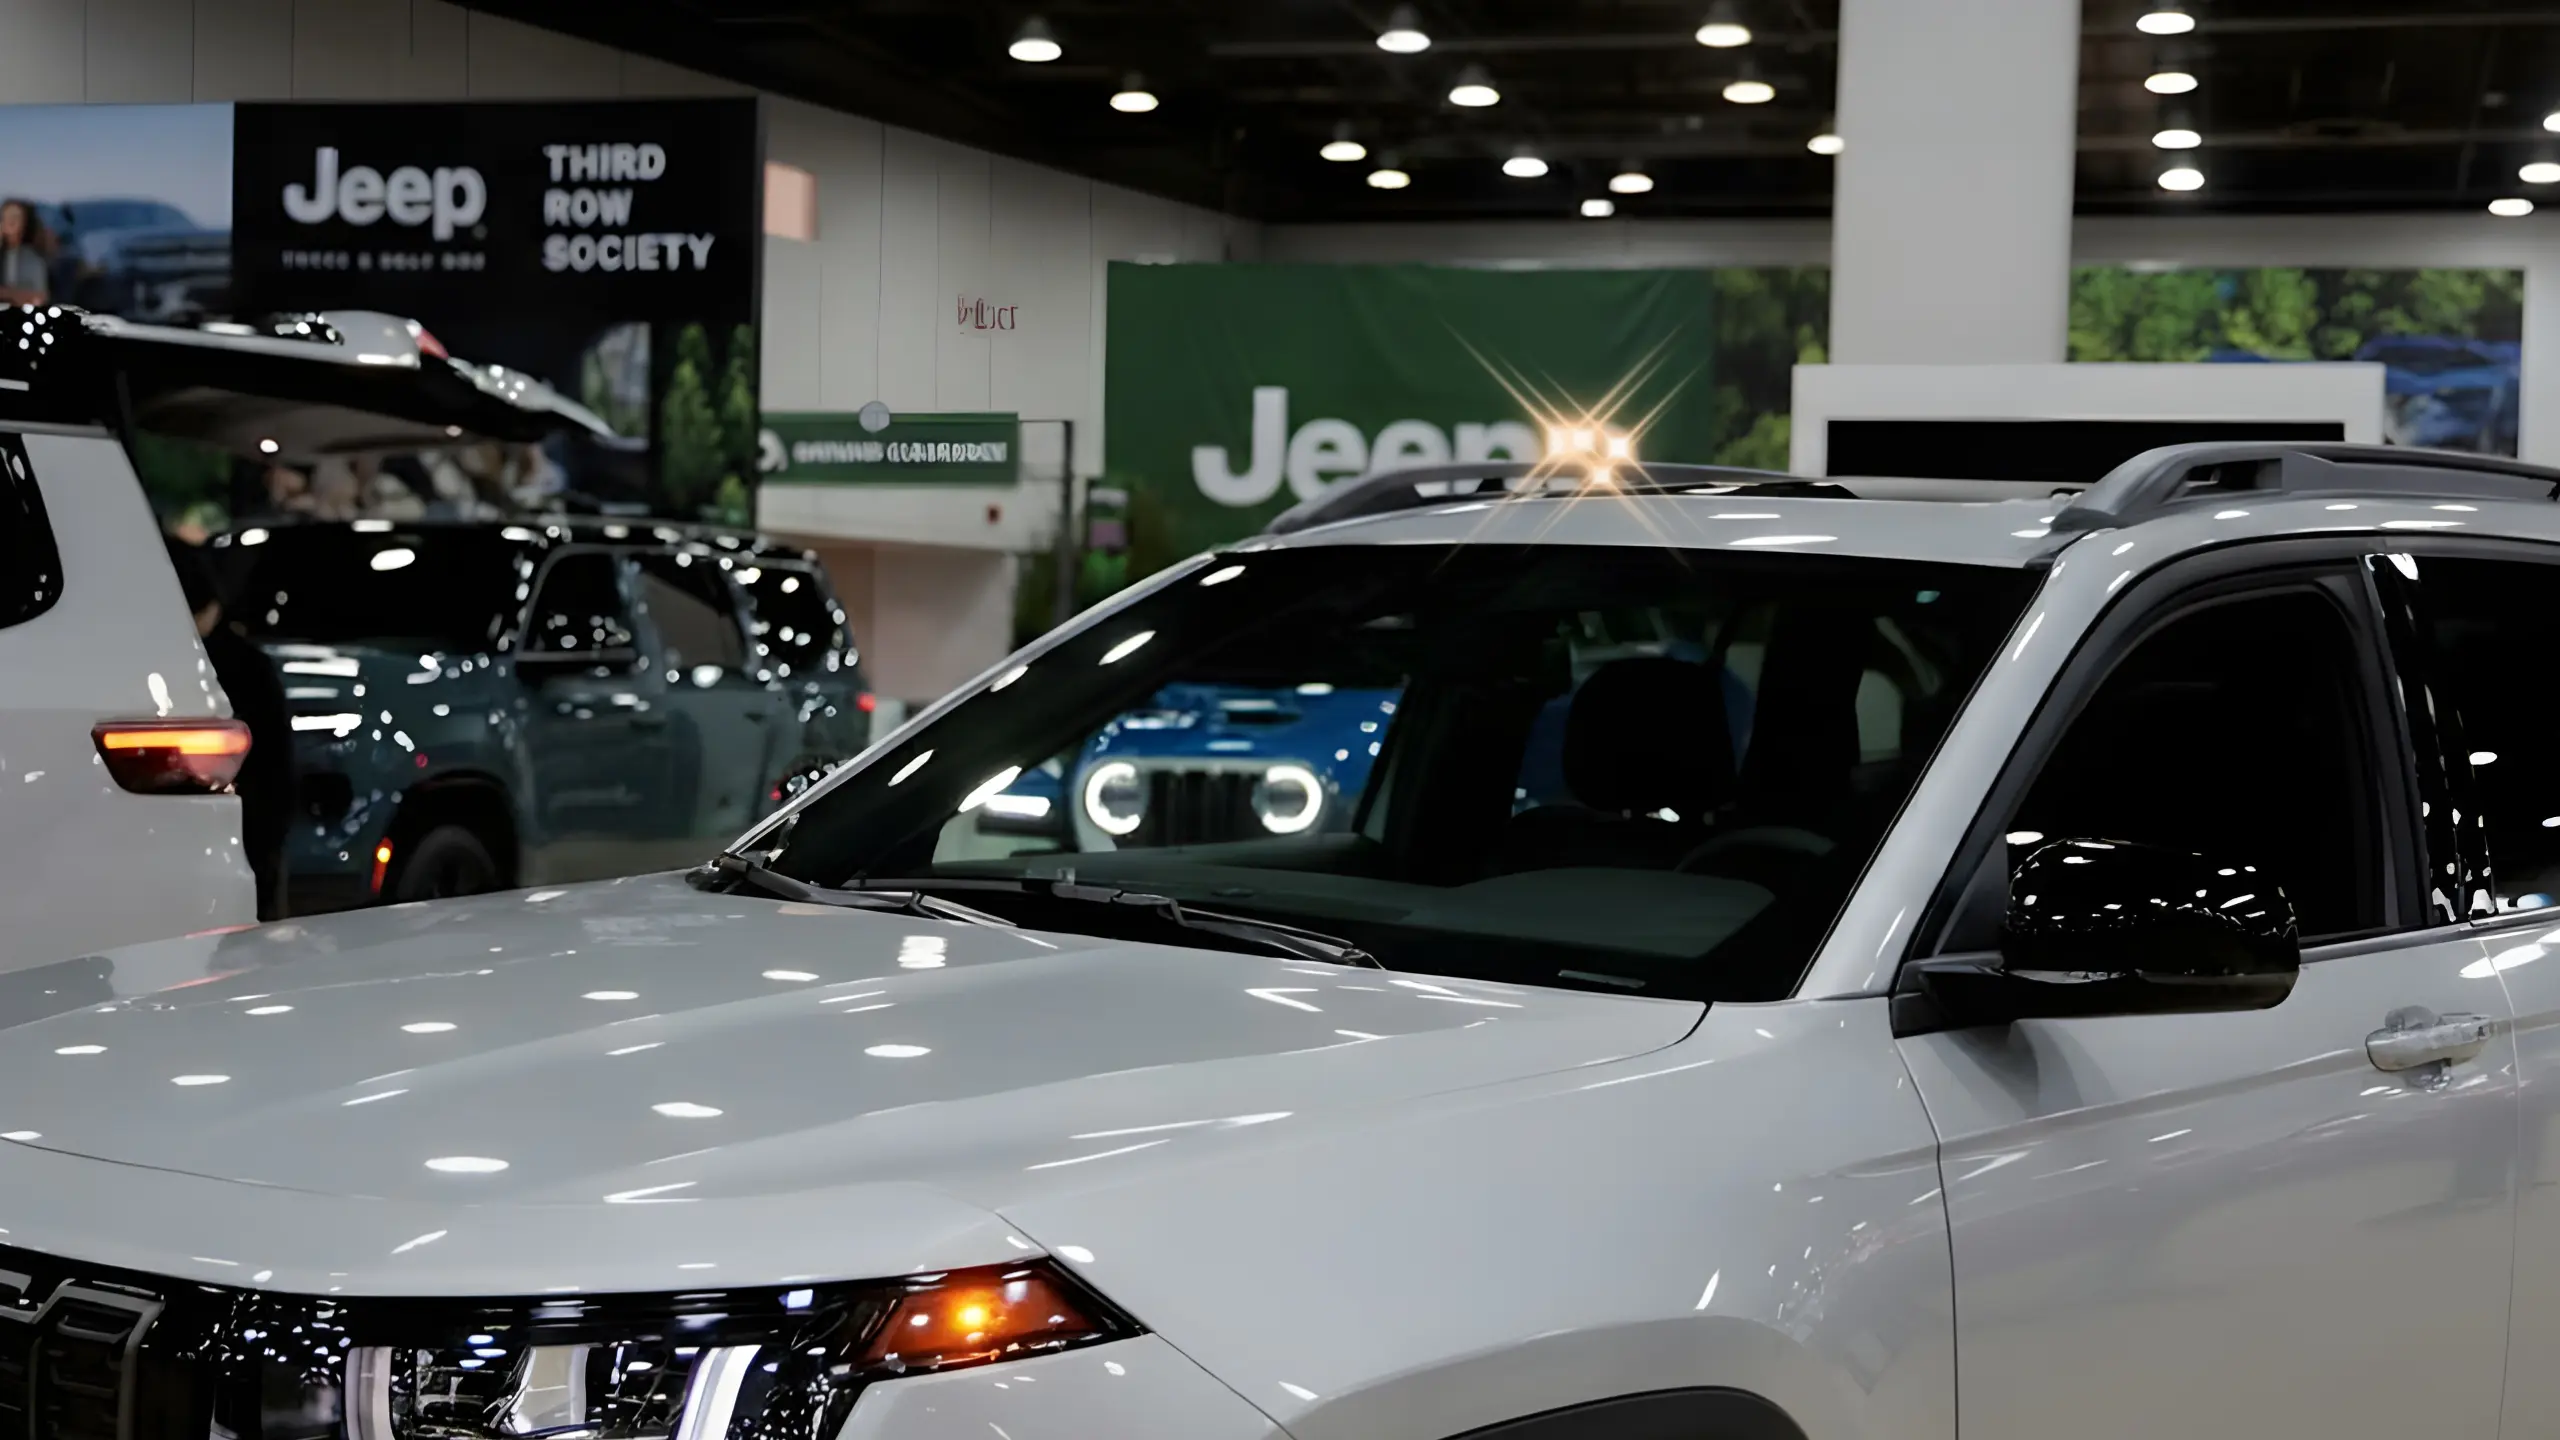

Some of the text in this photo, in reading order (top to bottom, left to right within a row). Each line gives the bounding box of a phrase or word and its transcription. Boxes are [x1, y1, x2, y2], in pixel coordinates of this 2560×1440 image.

[543, 142, 666, 182] THIRD
[283, 147, 487, 242] Jeep
[544, 187, 633, 228] ROW
[542, 232, 716, 273] SOCIETY
